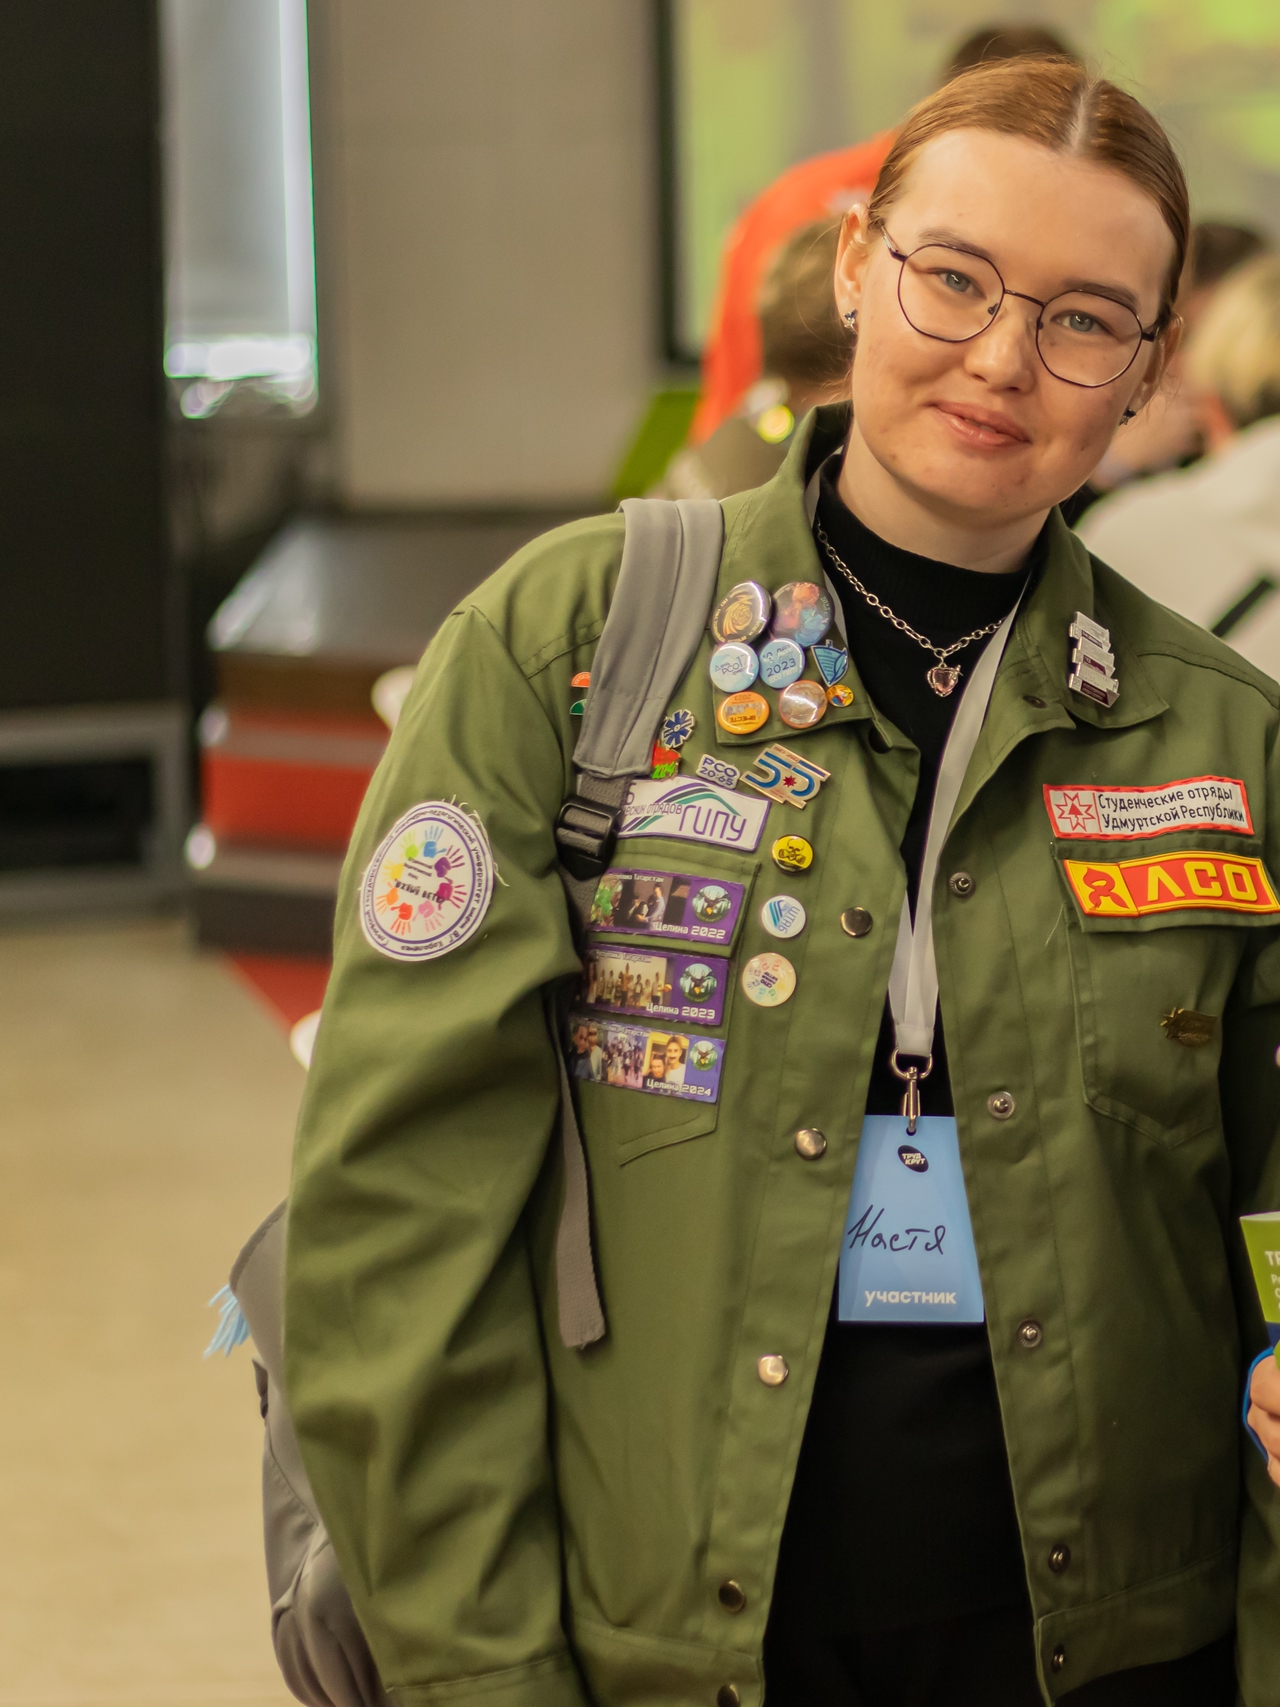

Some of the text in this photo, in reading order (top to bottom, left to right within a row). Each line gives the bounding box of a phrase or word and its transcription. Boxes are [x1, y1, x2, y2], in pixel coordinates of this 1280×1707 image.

[766, 657, 797, 678] 2023
[700, 766, 734, 786] 20:65
[703, 757, 738, 778] РСО
[1098, 786, 1233, 813] Студенческие отряды
[679, 805, 748, 842] ГИПУ
[1102, 802, 1245, 832] Удмуртской Республики
[1147, 861, 1257, 902] ЛСО
[654, 922, 726, 940] Целина 2022
[646, 1002, 716, 1020] Целина 2023
[646, 1078, 712, 1097] Целина 2024
[848, 1204, 946, 1255] Настя
[864, 1290, 957, 1307] участник
